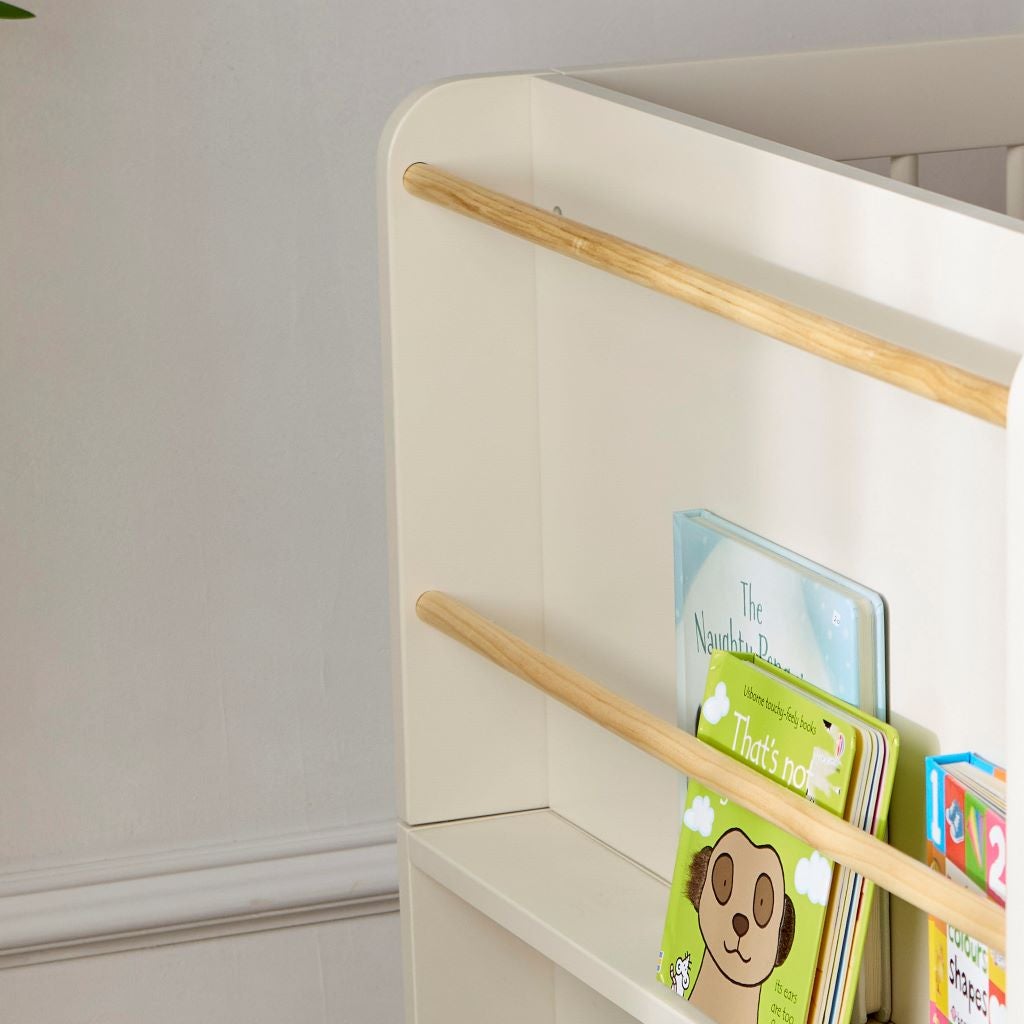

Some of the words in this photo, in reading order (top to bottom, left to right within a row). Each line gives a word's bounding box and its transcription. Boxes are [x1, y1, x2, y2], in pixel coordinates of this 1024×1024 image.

[740, 580, 763, 625] The
[743, 684, 765, 708] Usborne
[765, 697, 800, 730] touchy-feely
[799, 714, 818, 736] books
[731, 710, 779, 775] That's
[930, 768, 941, 845] 1
[988, 825, 1007, 900] 2
[948, 923, 987, 974] colours
[770, 1003, 782, 1018] are
[783, 988, 799, 1005] ears
[948, 954, 987, 1017] shapes
